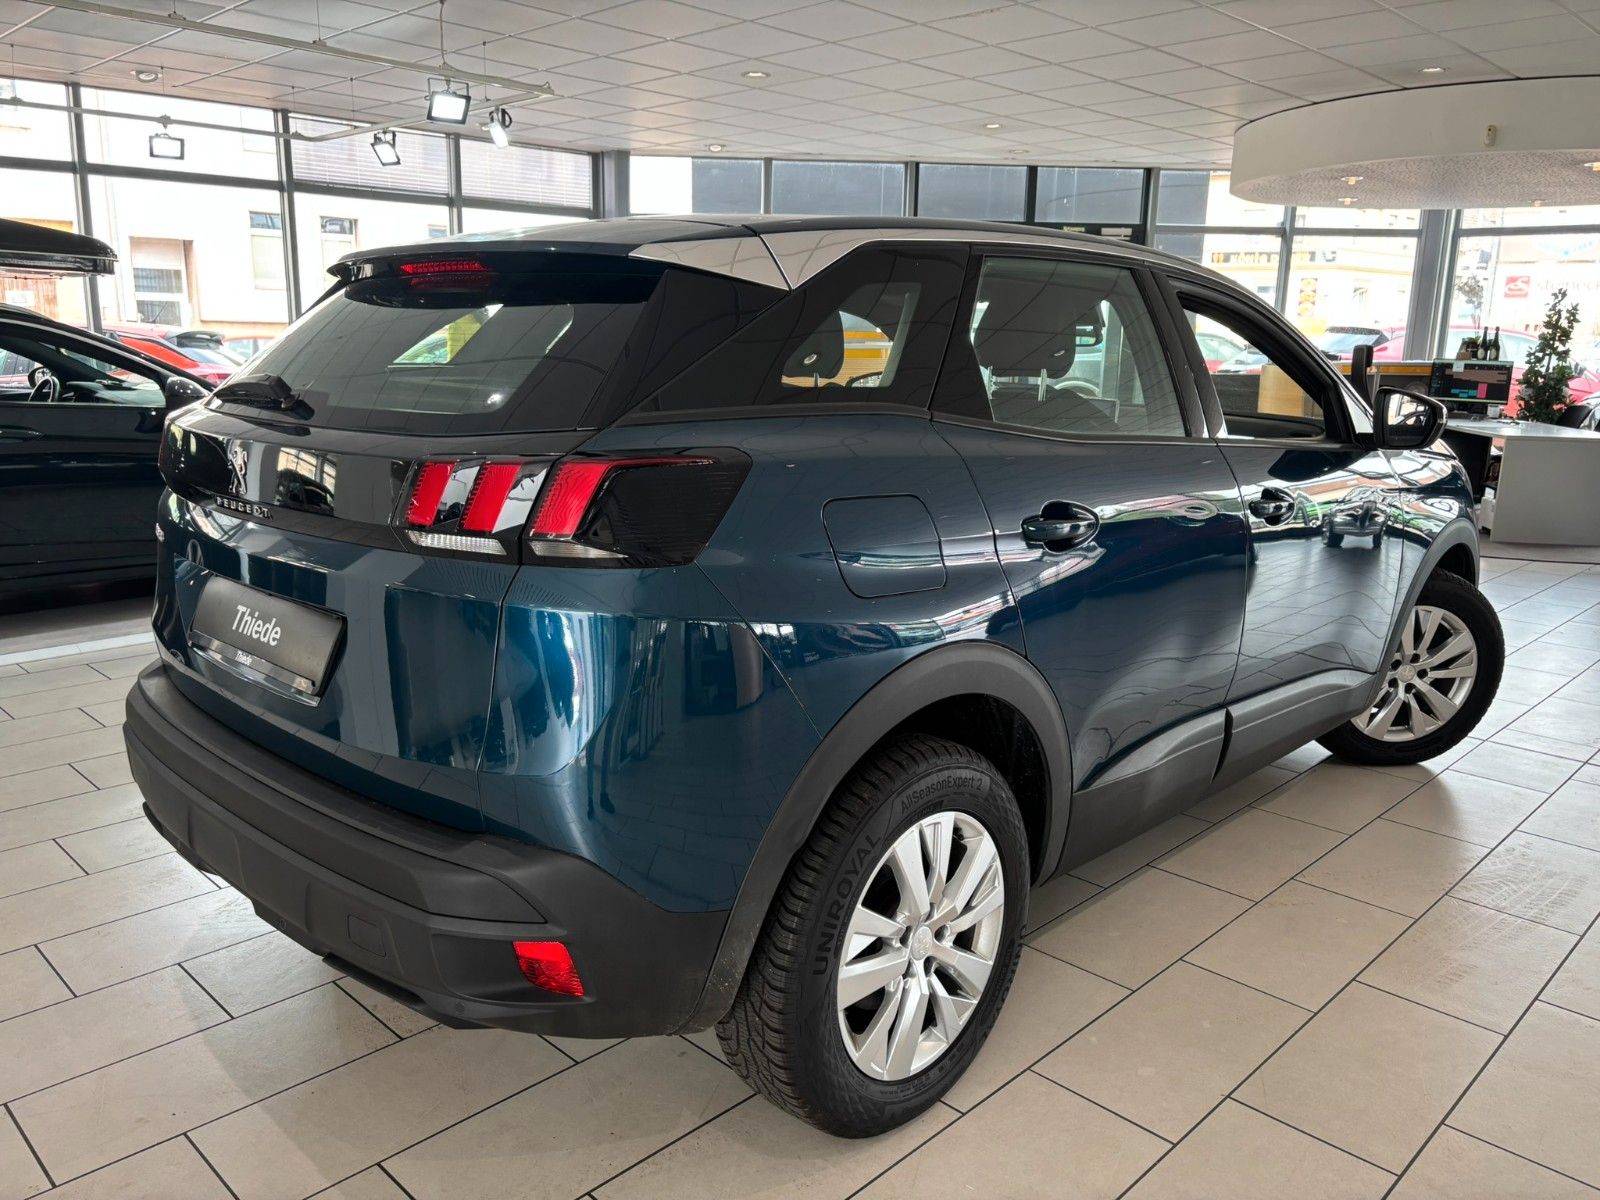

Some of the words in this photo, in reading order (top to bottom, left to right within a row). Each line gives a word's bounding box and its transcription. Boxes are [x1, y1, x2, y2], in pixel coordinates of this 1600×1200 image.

[216, 496, 269, 518] PEUGEOT
[232, 604, 281, 646] Thiede
[901, 775, 975, 815] AllSeasonExpert
[976, 778, 983, 791] 2
[812, 834, 882, 976] UNIROYAL
